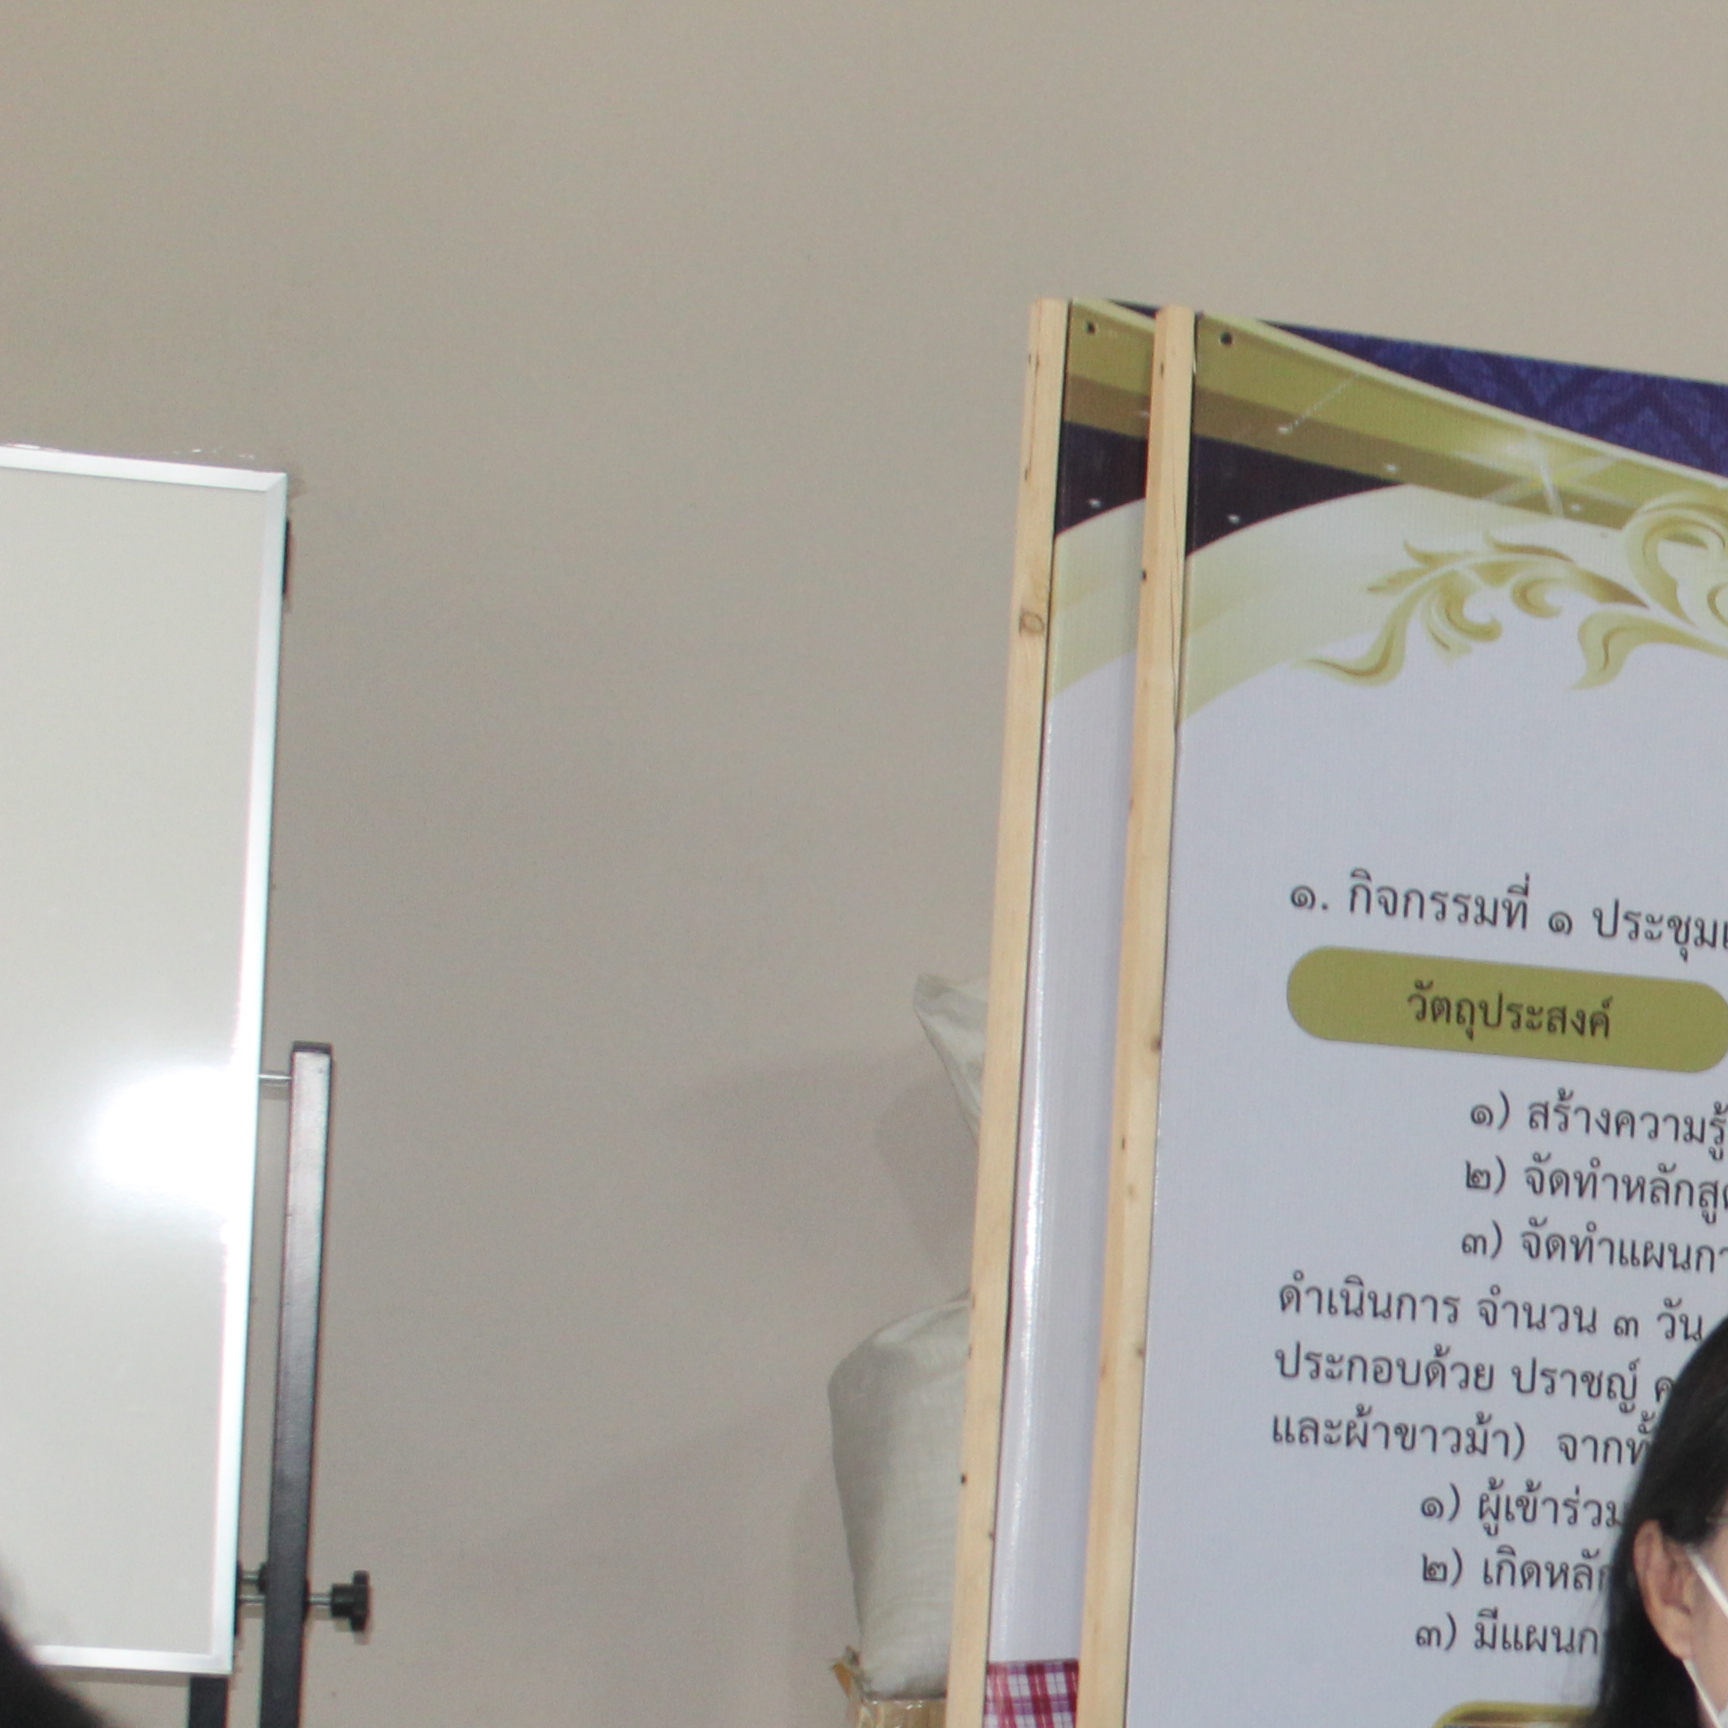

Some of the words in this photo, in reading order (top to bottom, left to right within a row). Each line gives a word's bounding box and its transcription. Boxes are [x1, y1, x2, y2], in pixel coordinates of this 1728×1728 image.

[1288, 878, 1330, 913] ๑.
[1348, 868, 1531, 932] กิจกรรมที่
[1547, 904, 1574, 936] ๑
[1406, 980, 1614, 1044] วัตถุประสงค์
[1469, 1089, 1512, 1135] ๑)
[1464, 1153, 1508, 1199] ๒)
[1460, 1218, 1504, 1264] ๓)
[1277, 1270, 1462, 1327] ดำเนินการ
[1476, 1284, 1598, 1336] จำนวน
[1612, 1310, 1640, 1339] ๓
[1655, 1297, 1705, 1344] วัน
[1273, 1336, 1496, 1394] ประกอบด้วย
[1271, 1406, 1527, 1464] และผ้าขาวม้า)
[1419, 1481, 1462, 1526] ๑)
[1420, 1546, 1464, 1590] ๒)
[1414, 1613, 1458, 1654] ๓)
